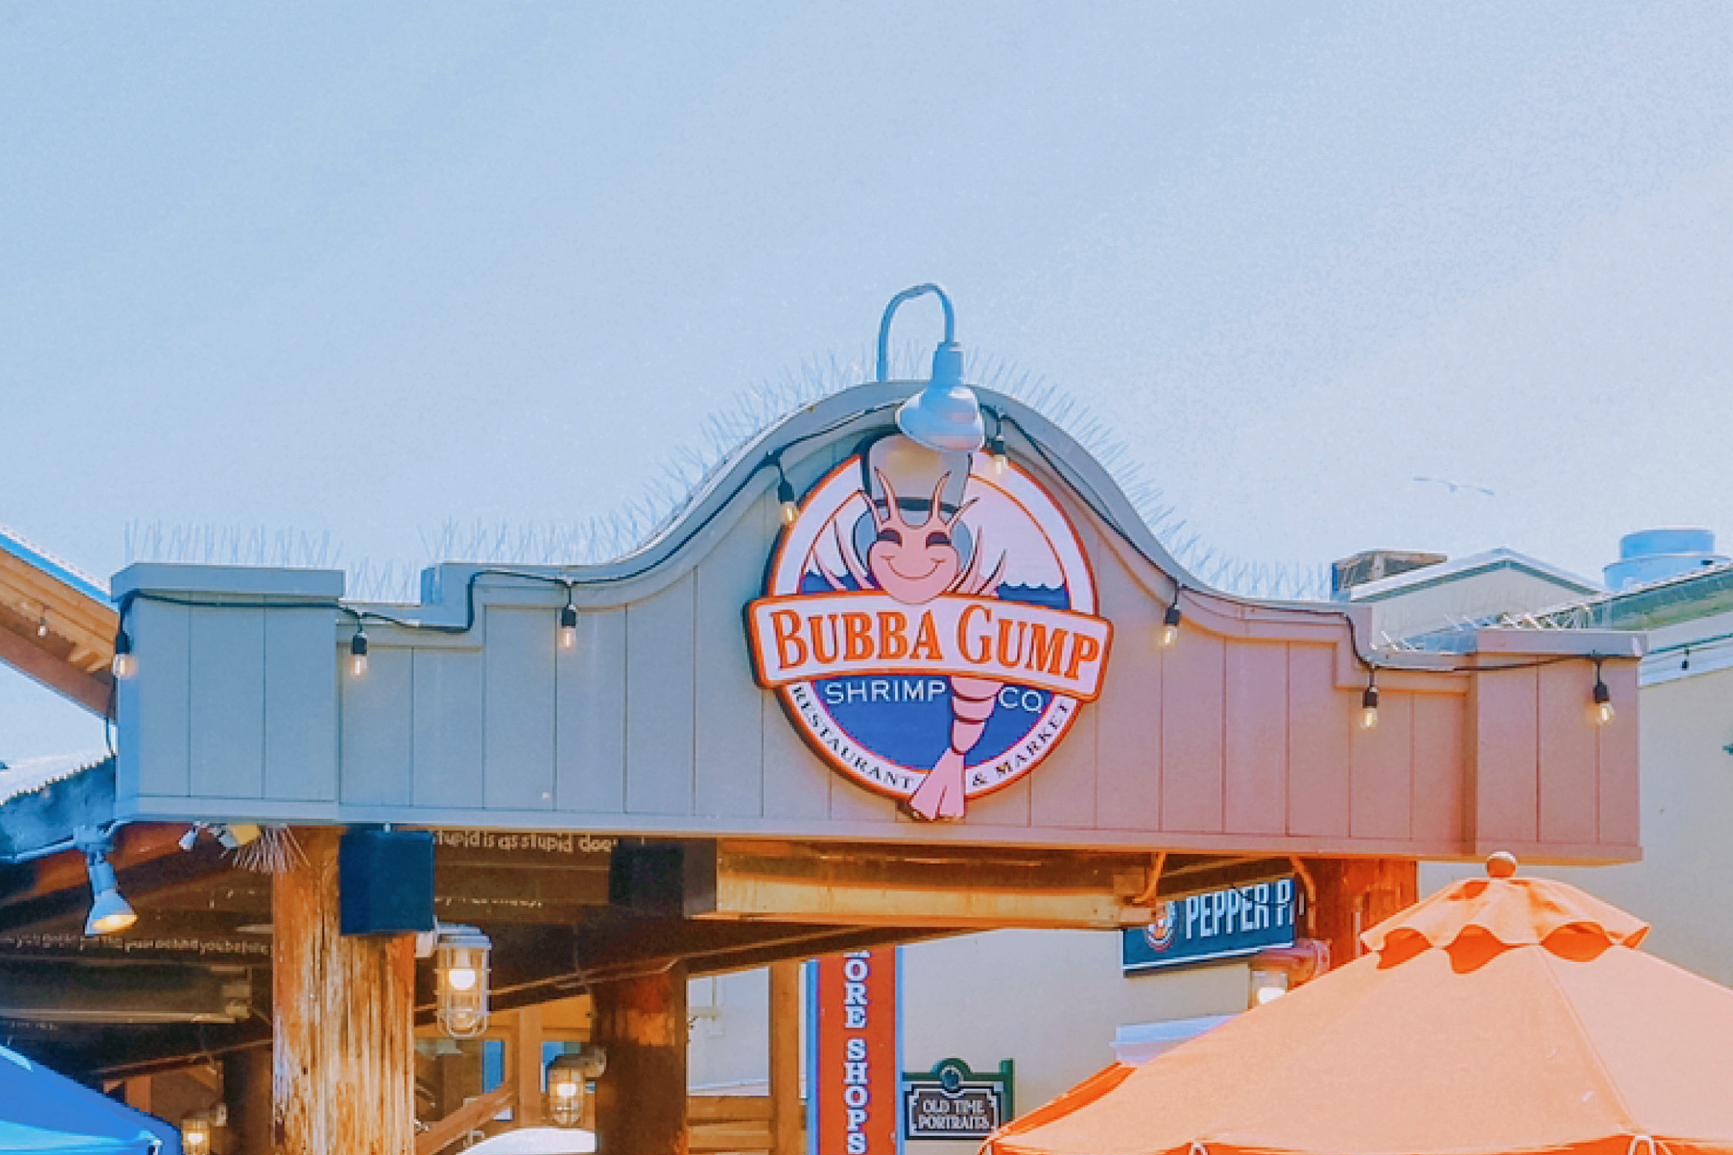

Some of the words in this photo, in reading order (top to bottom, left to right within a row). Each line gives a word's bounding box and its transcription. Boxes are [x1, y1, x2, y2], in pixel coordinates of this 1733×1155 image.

[769, 608, 944, 671] BUBBA
[957, 603, 1100, 681] GUMP
[824, 679, 947, 704] SHRIMP
[792, 685, 913, 789] RESTAURANT
[972, 772, 988, 787] &
[995, 703, 1070, 776] MARKET
[434, 829, 480, 848] tupid
[521, 832, 574, 853] stupid
[1186, 883, 1270, 939] PEPPER
[843, 951, 870, 1028] ORE
[843, 1038, 870, 1155] SHOPS
[918, 1114, 990, 1130] PORTRAITS
[923, 1099, 950, 1113] OLD
[953, 1099, 985, 1113] TIME
